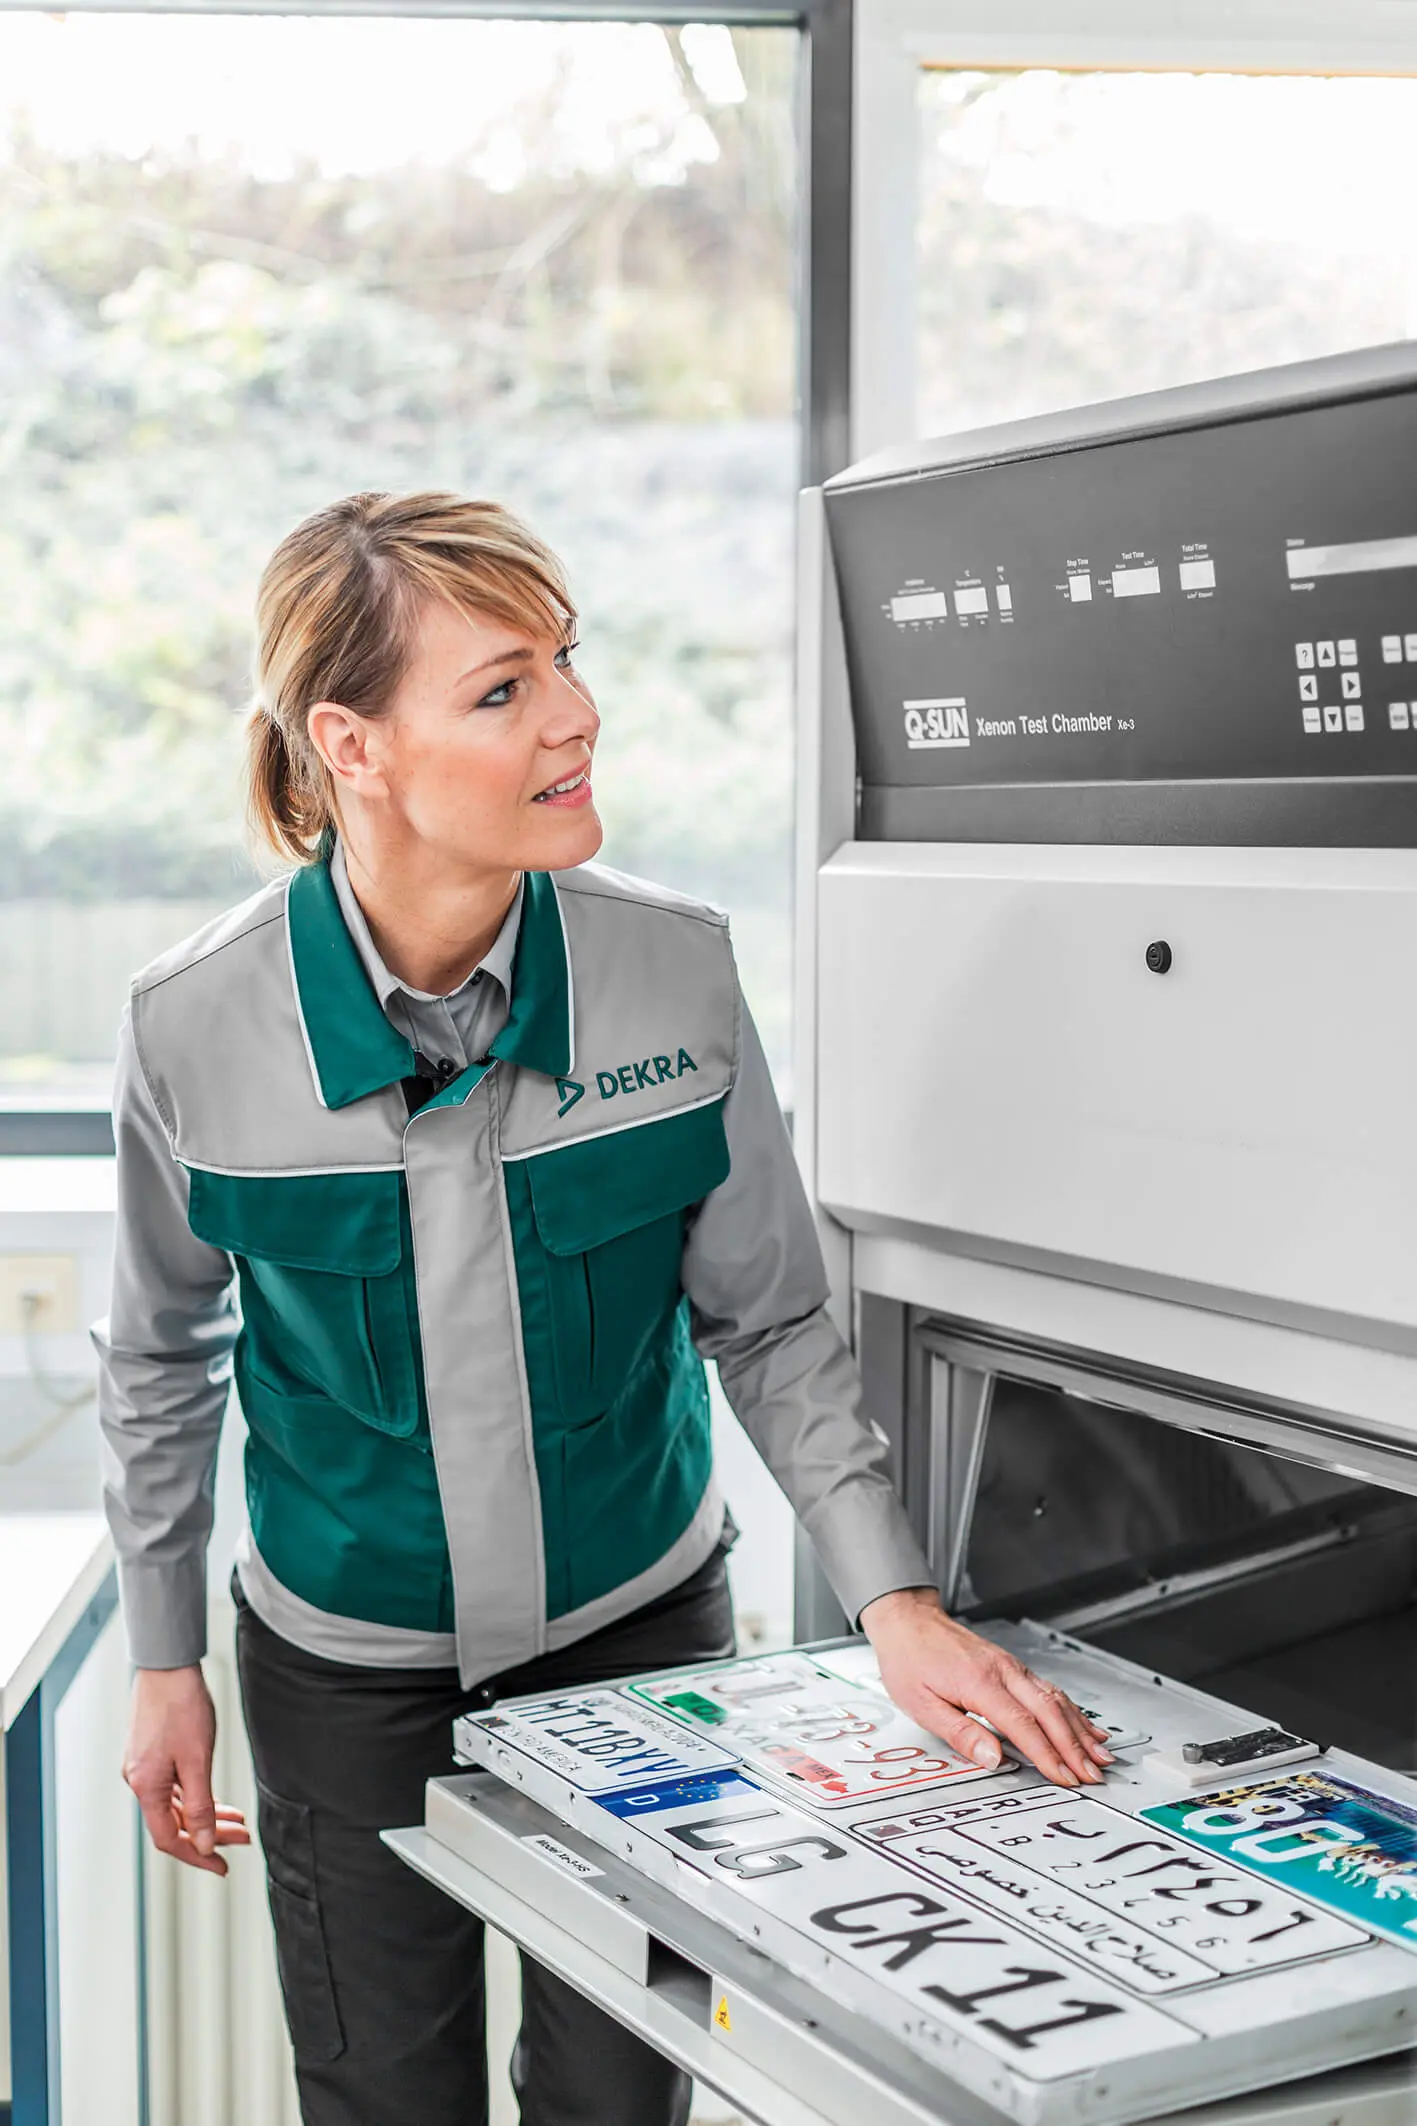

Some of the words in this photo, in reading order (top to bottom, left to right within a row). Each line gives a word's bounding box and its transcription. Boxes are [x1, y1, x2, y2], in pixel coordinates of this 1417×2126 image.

[976, 717, 1016, 737] Xenon
[1019, 715, 1048, 735] Test
[1052, 711, 1112, 733] Chamber
[1117, 718, 1135, 731] Xe-3
[596, 1047, 698, 1100] DEKRA
[623, 1793, 660, 1806] D
[664, 1807, 848, 1880] LG
[810, 1891, 1009, 1972] CK
[920, 1965, 1127, 2050] 11
